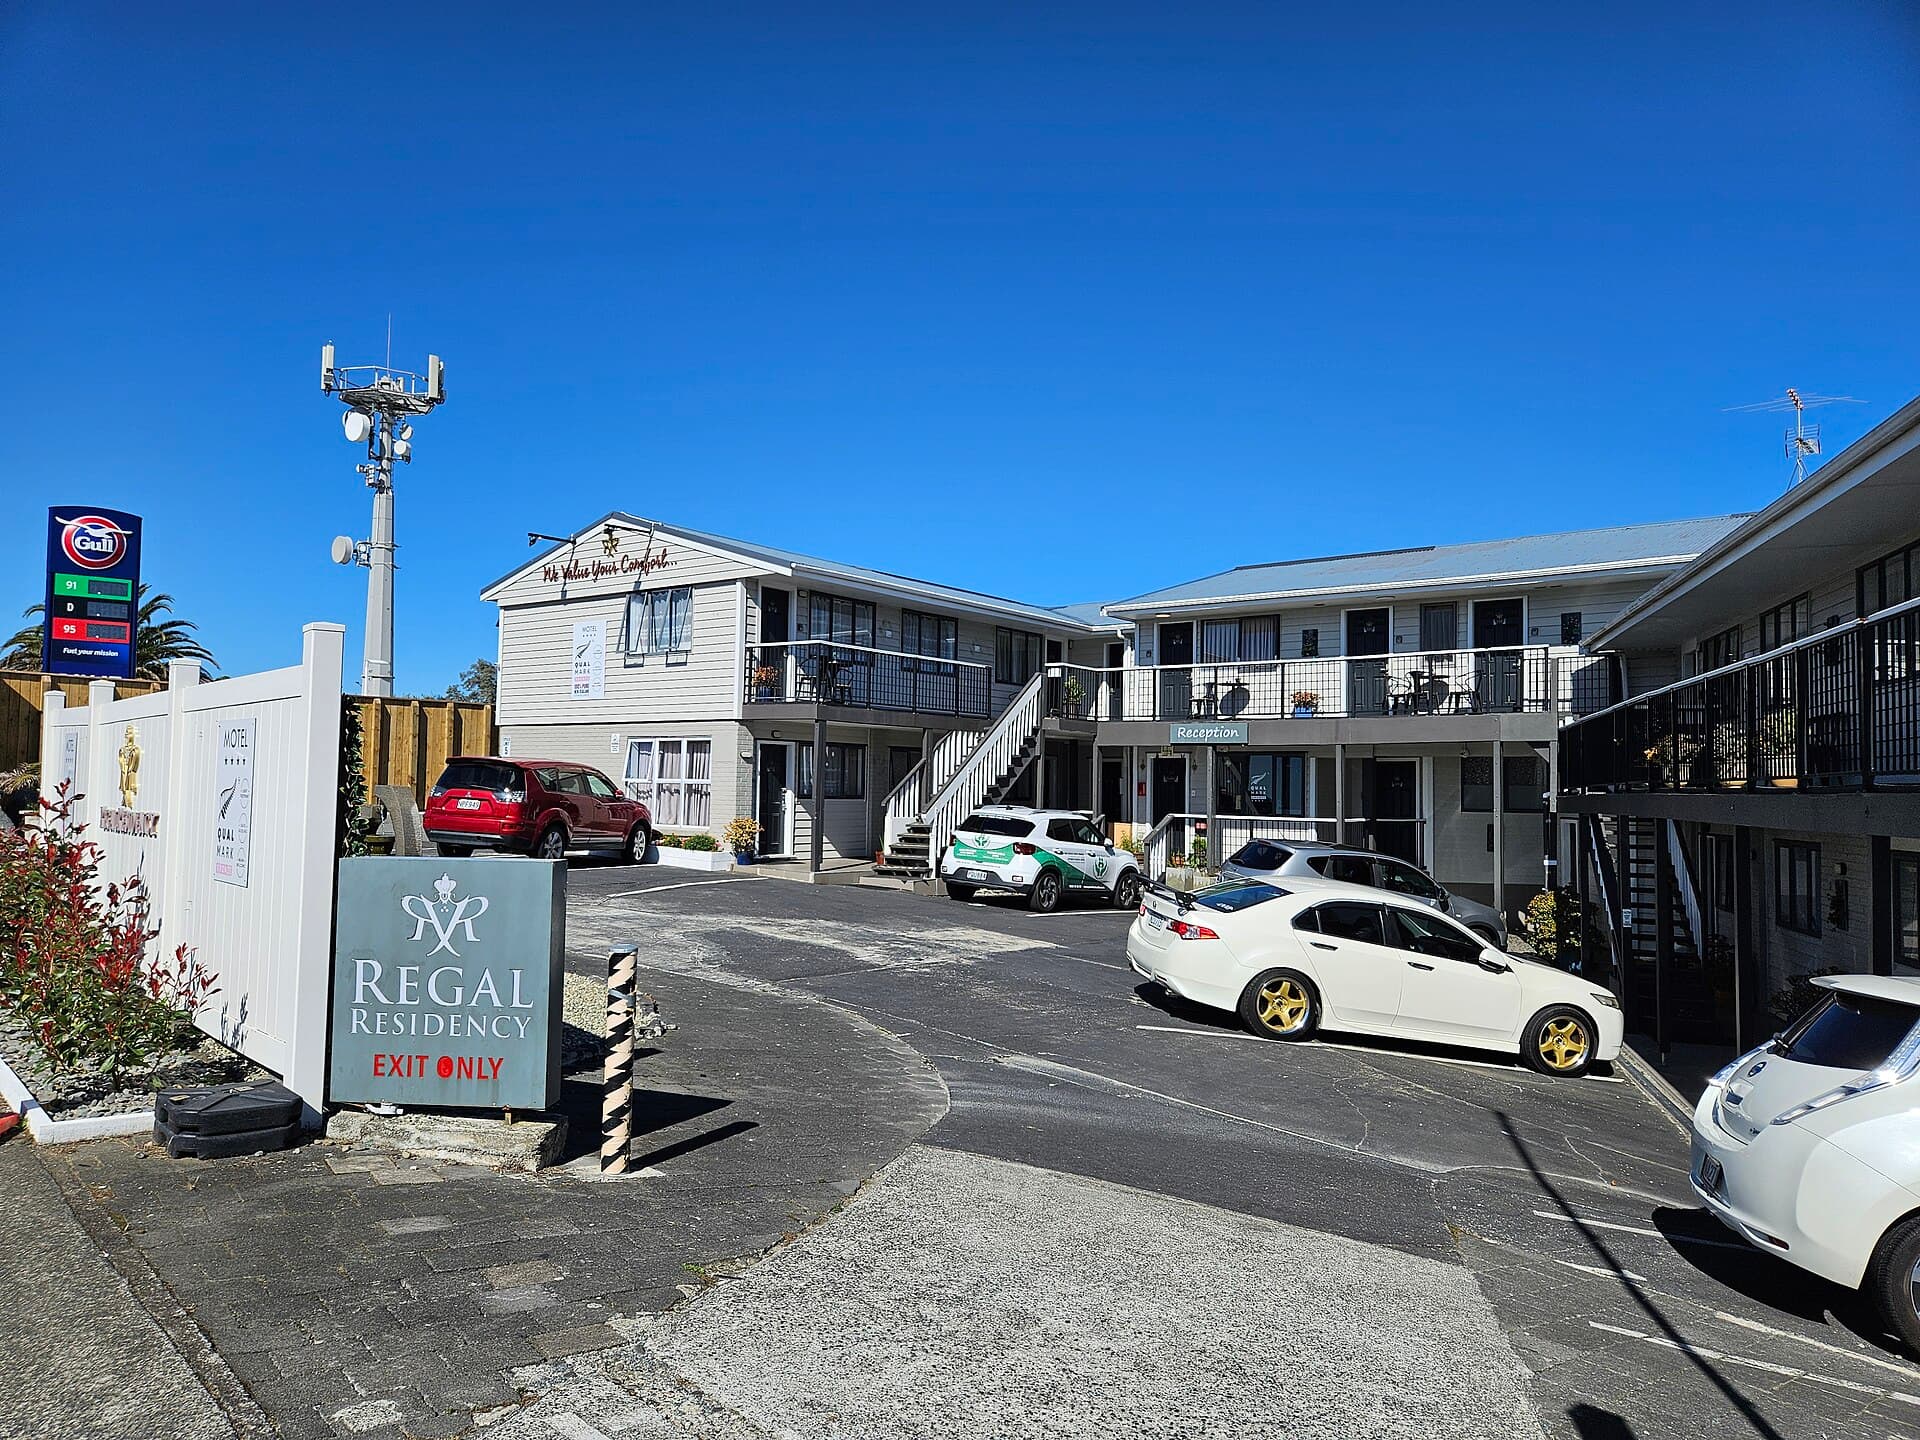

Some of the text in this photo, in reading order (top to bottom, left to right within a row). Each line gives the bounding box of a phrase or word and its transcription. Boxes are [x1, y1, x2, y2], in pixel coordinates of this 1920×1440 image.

[75, 536, 114, 553] Gull
[543, 565, 559, 583] We
[561, 559, 590, 580] Value
[591, 560, 619, 582] Your
[66, 581, 77, 590] 91
[66, 602, 74, 612] D
[63, 625, 76, 634] 95
[63, 647, 78, 655] Fuel
[94, 649, 119, 657] mission
[223, 729, 248, 748] MOTEL
[1177, 726, 1240, 742] Reception
[217, 828, 235, 842] QUAL
[216, 845, 234, 859] MARK
[351, 958, 534, 1009] REGAL
[350, 1008, 532, 1039] RESIDENCY
[372, 1054, 505, 1081] EXIT ONLY
